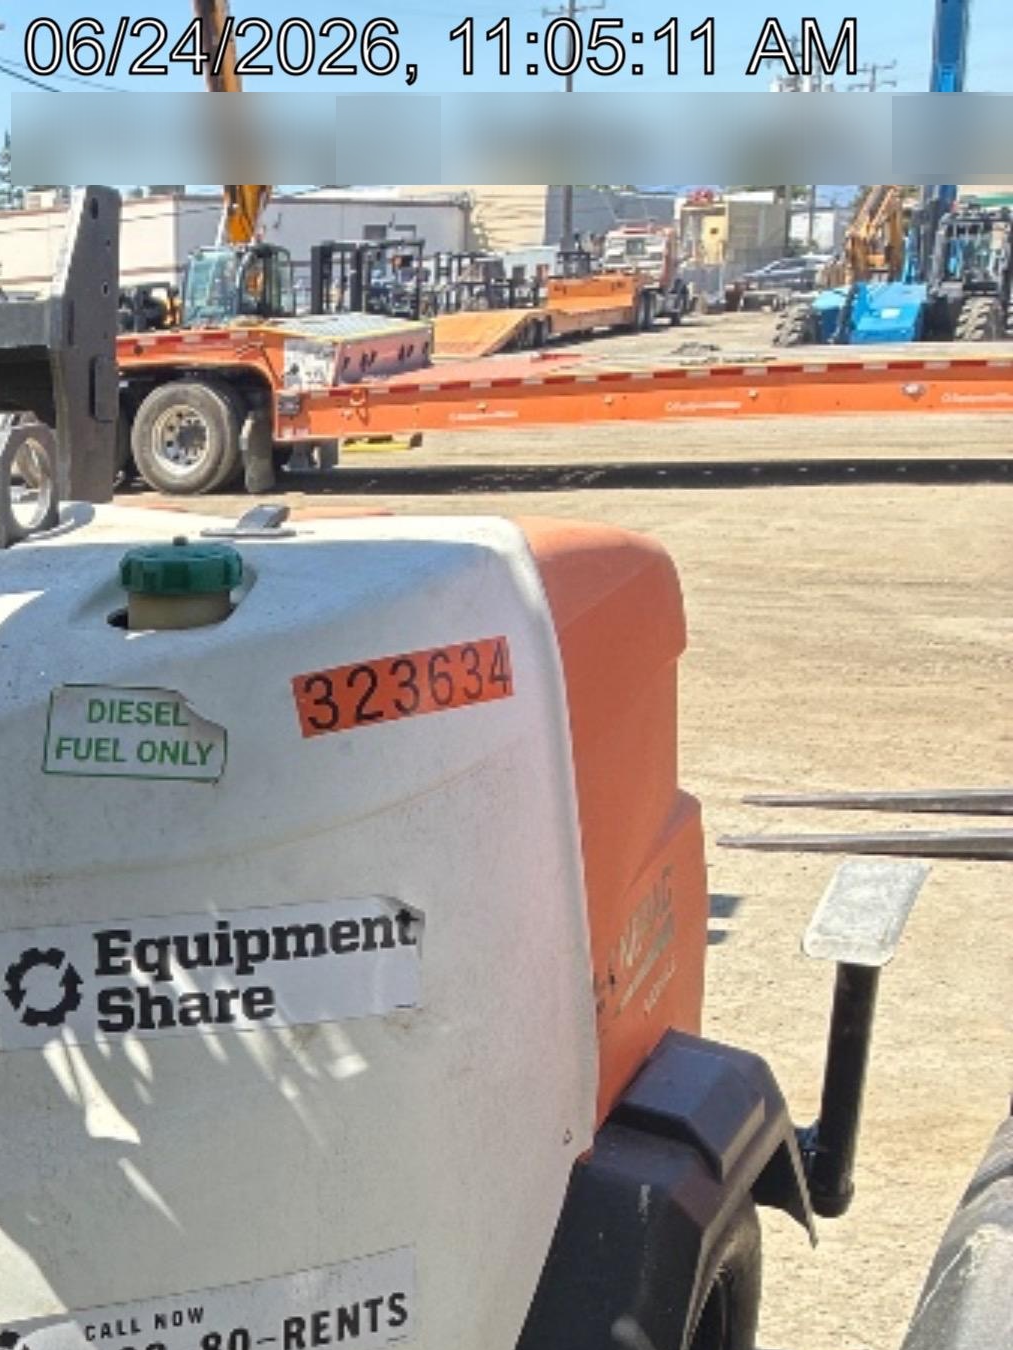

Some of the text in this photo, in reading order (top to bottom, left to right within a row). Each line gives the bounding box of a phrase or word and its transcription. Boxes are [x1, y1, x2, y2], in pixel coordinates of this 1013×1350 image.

[302, 639, 512, 730] 323634
[87, 698, 189, 727] DIESEL
[55, 736, 214, 766] FUEL ONLY
[93, 907, 420, 982] Equipment
[96, 981, 276, 1034] Share
[85, 1306, 205, 1342] CALL NOW
